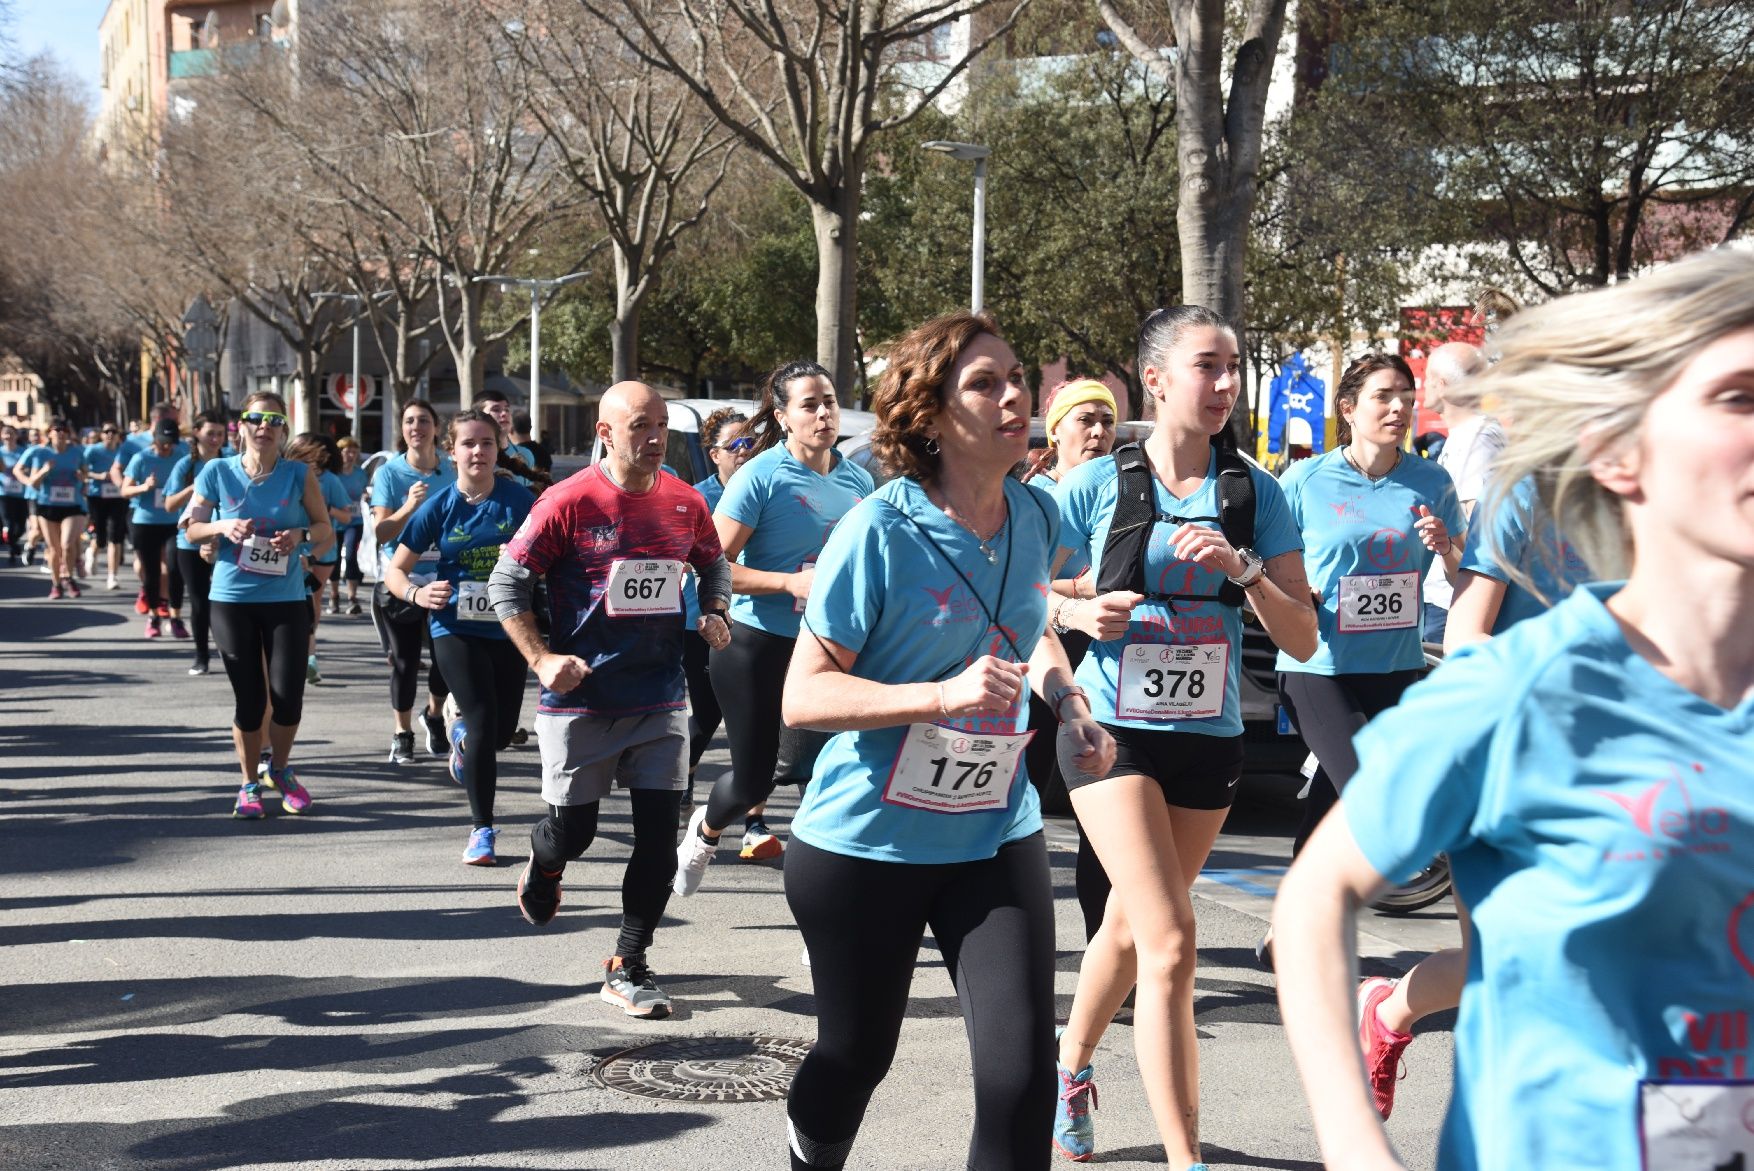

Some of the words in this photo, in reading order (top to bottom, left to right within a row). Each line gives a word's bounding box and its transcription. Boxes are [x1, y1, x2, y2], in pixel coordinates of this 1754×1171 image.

[249, 547, 281, 565] 544
[623, 577, 667, 600] 667
[1357, 592, 1403, 615] 236
[1169, 614, 1224, 634] CURSA
[1143, 668, 1205, 699] 378
[930, 756, 998, 791] 176
[1682, 1011, 1748, 1053] VII
